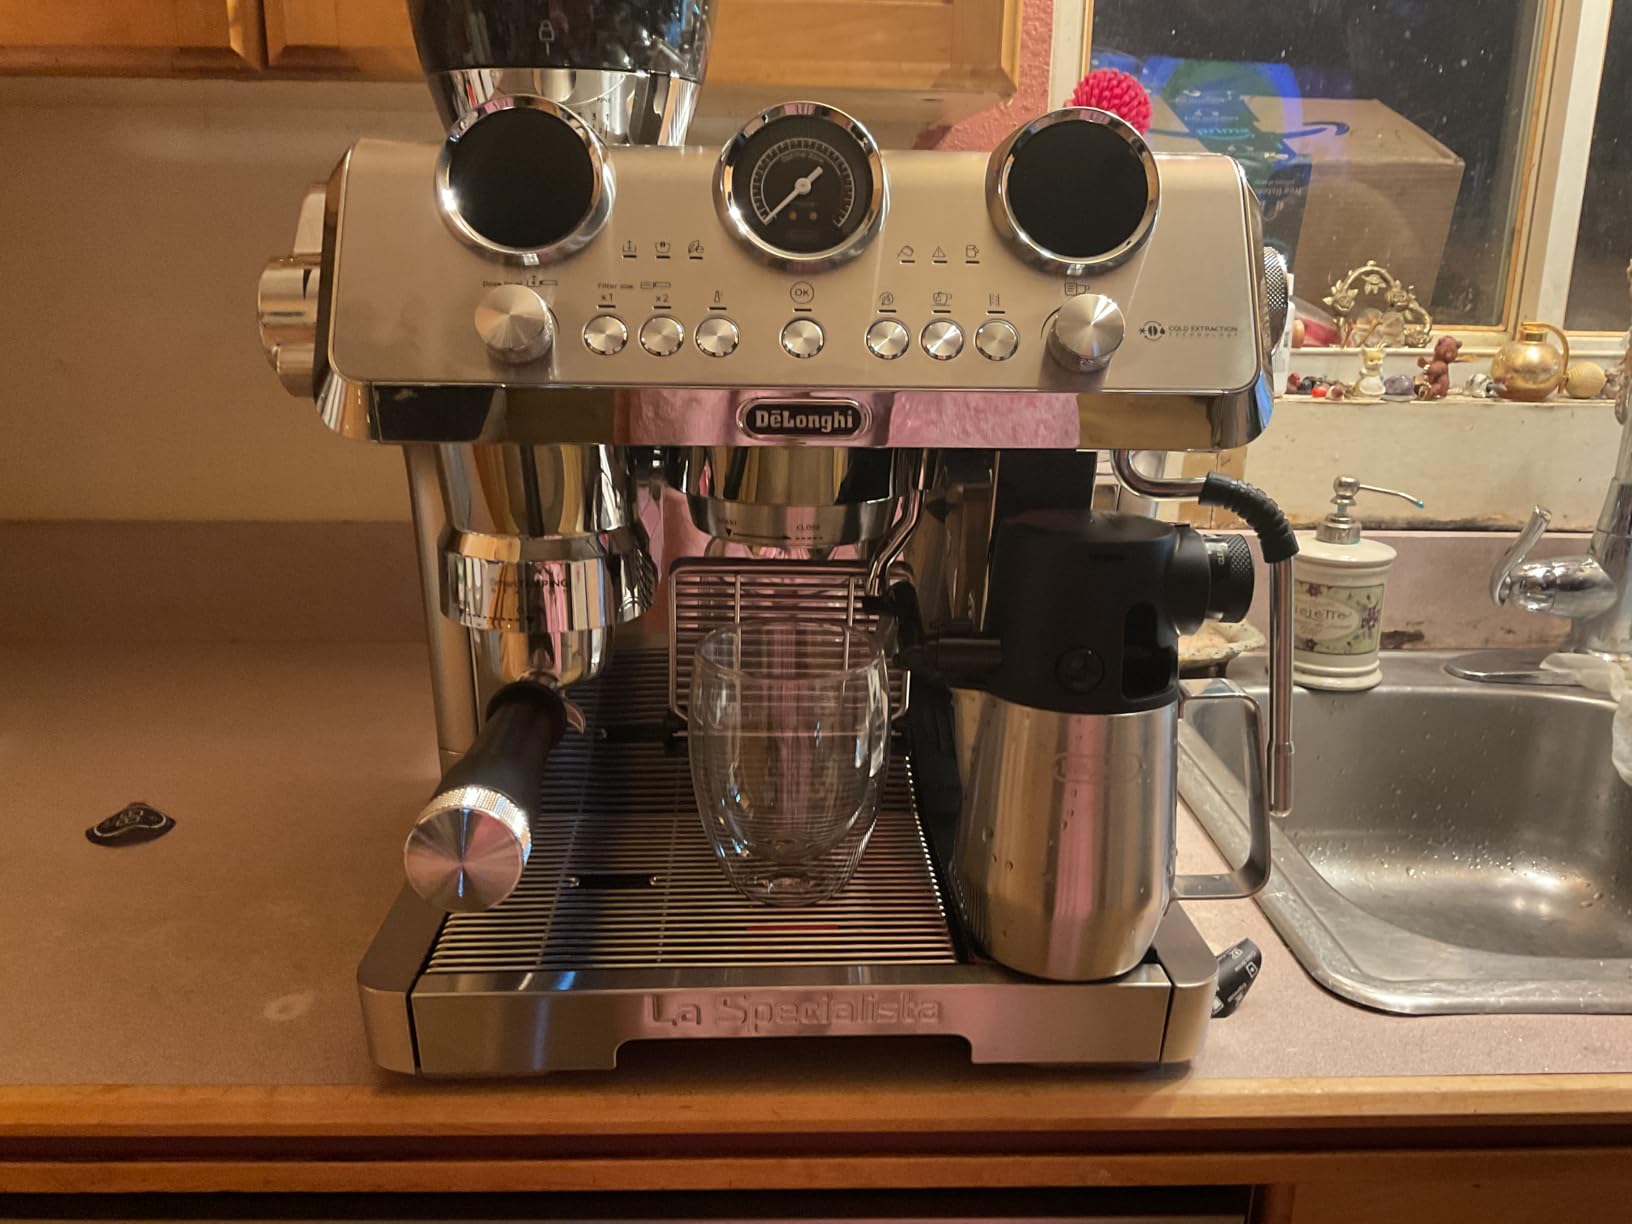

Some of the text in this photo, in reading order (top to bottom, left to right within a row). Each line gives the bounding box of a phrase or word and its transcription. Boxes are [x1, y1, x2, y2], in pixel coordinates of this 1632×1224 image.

[794, 287, 811, 297] OK
[643, 993, 943, 1033] La Specialista
